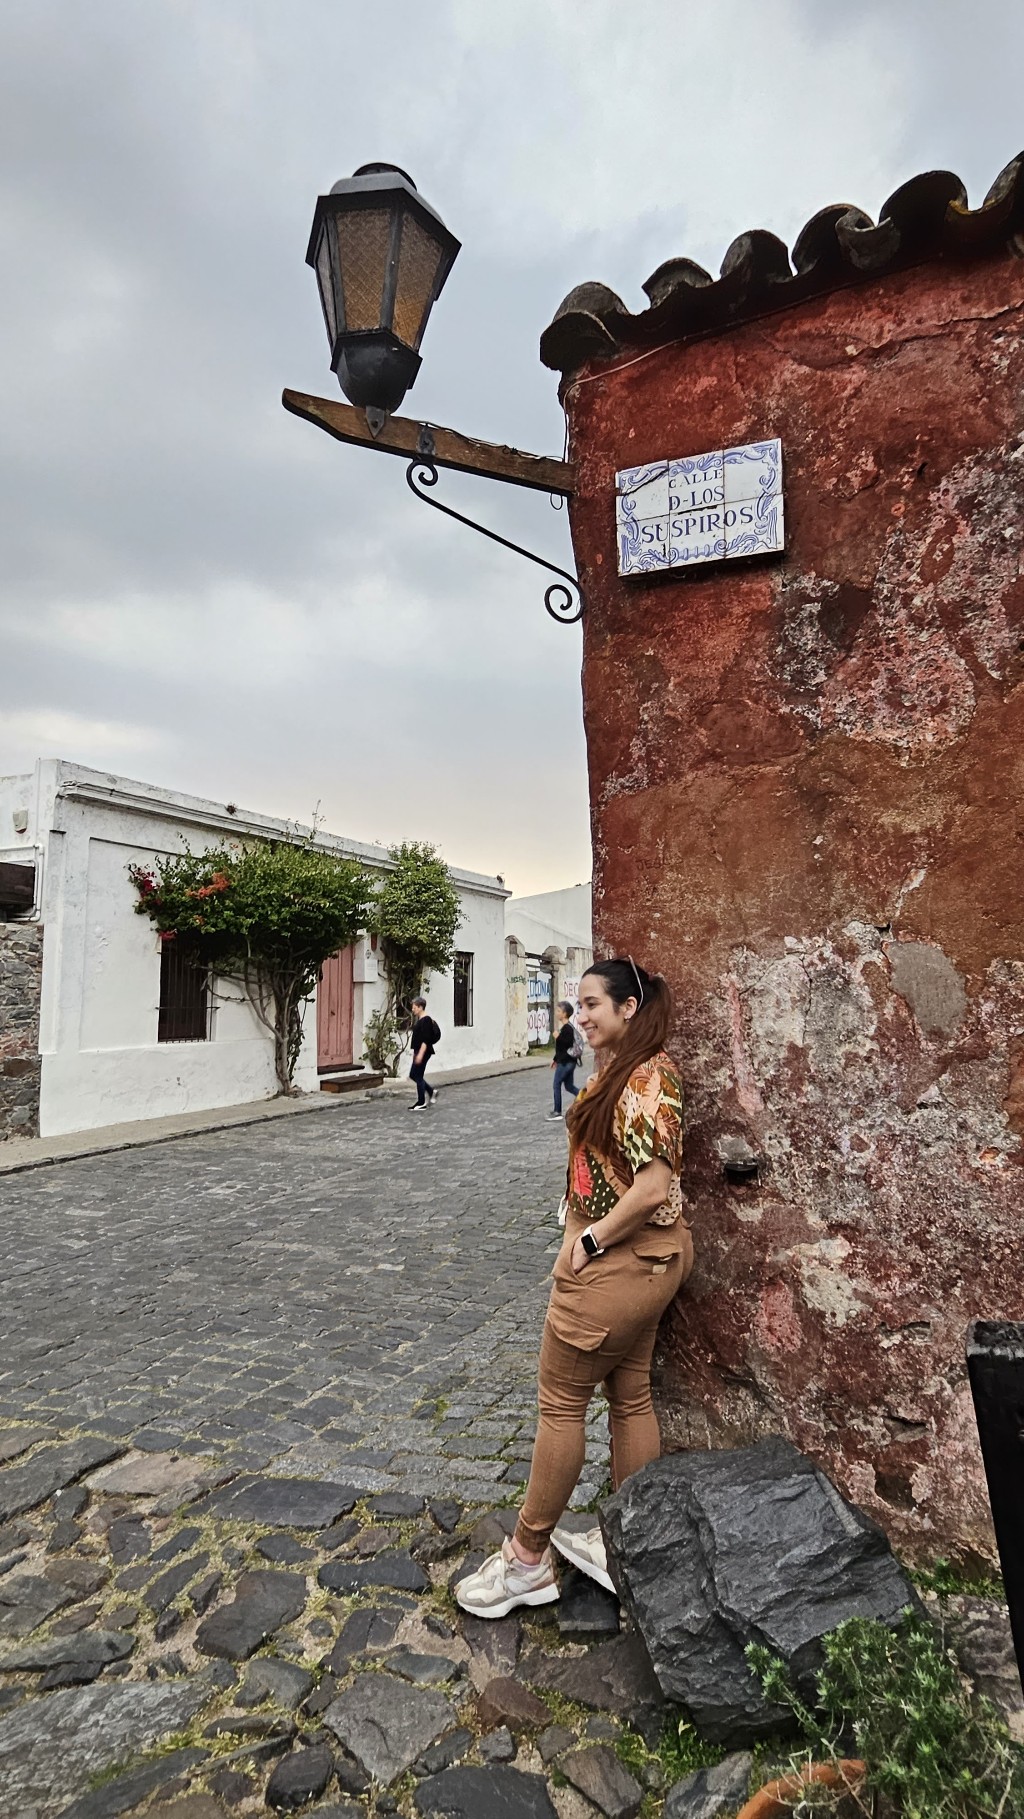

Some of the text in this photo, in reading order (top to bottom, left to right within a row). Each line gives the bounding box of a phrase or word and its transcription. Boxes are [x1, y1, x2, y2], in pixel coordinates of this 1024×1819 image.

[668, 469, 723, 489] CALLE
[669, 486, 725, 511] D-LOS
[641, 506, 754, 544] SUSPIROS
